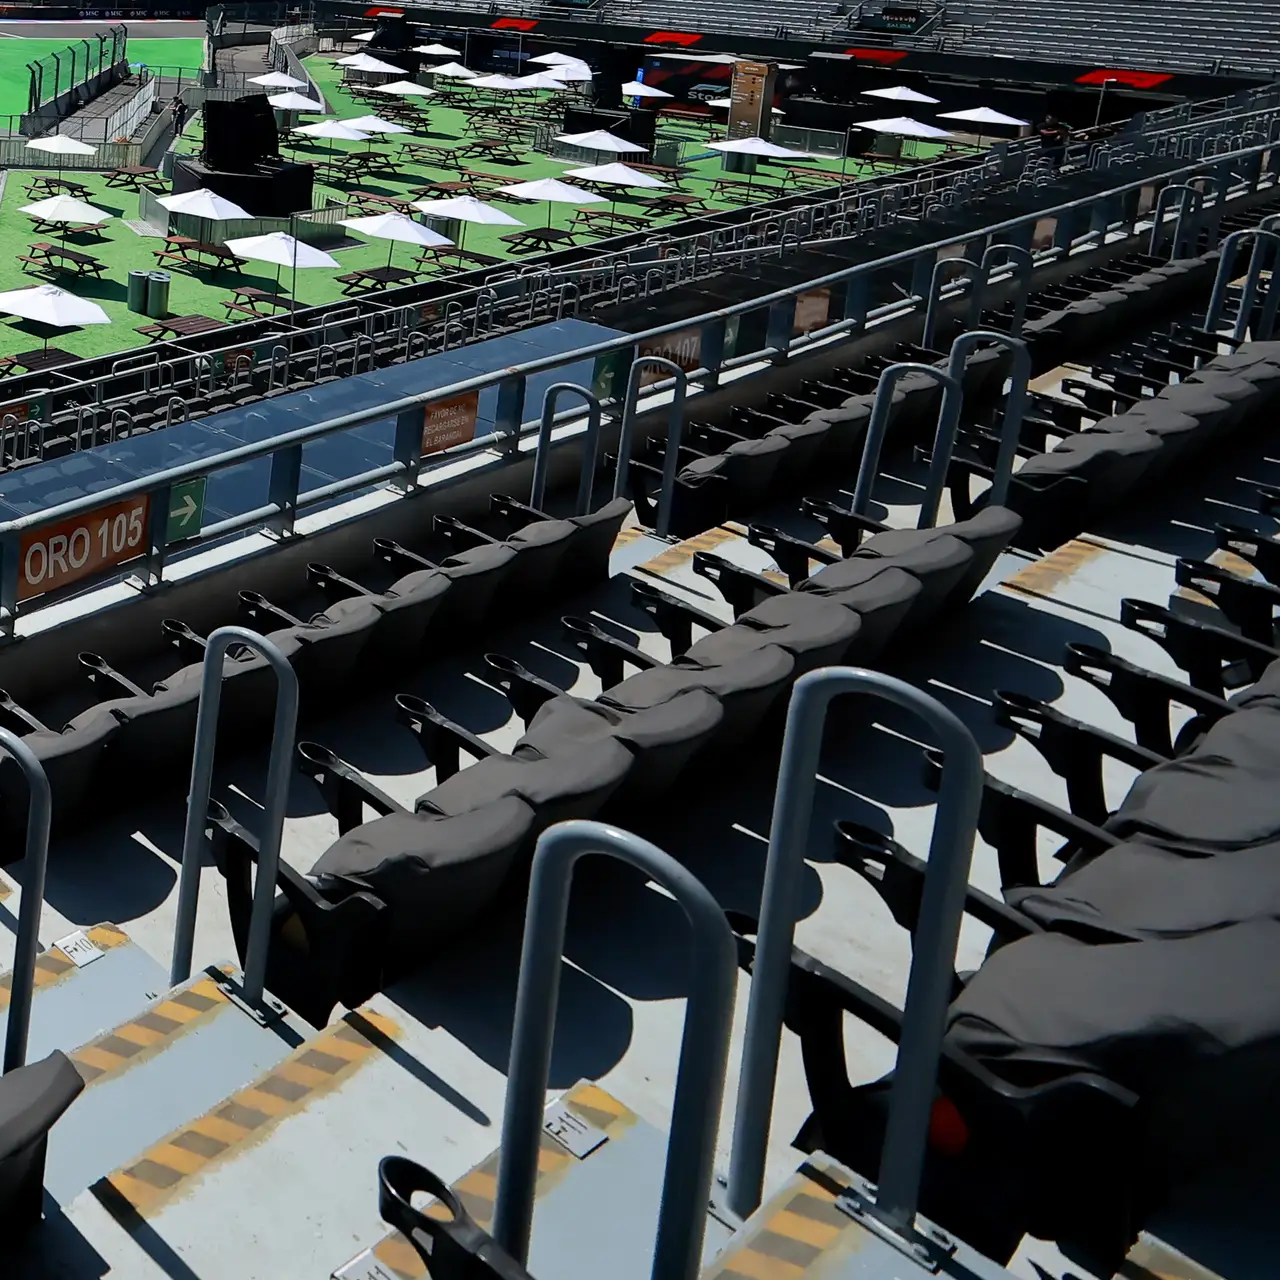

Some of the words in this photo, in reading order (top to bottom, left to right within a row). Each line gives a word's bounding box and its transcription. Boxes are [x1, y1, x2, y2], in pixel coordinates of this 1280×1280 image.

[431, 408, 449, 421] FAVOR
[24, 526, 90, 586] ORO
[97, 506, 144, 559] 105
